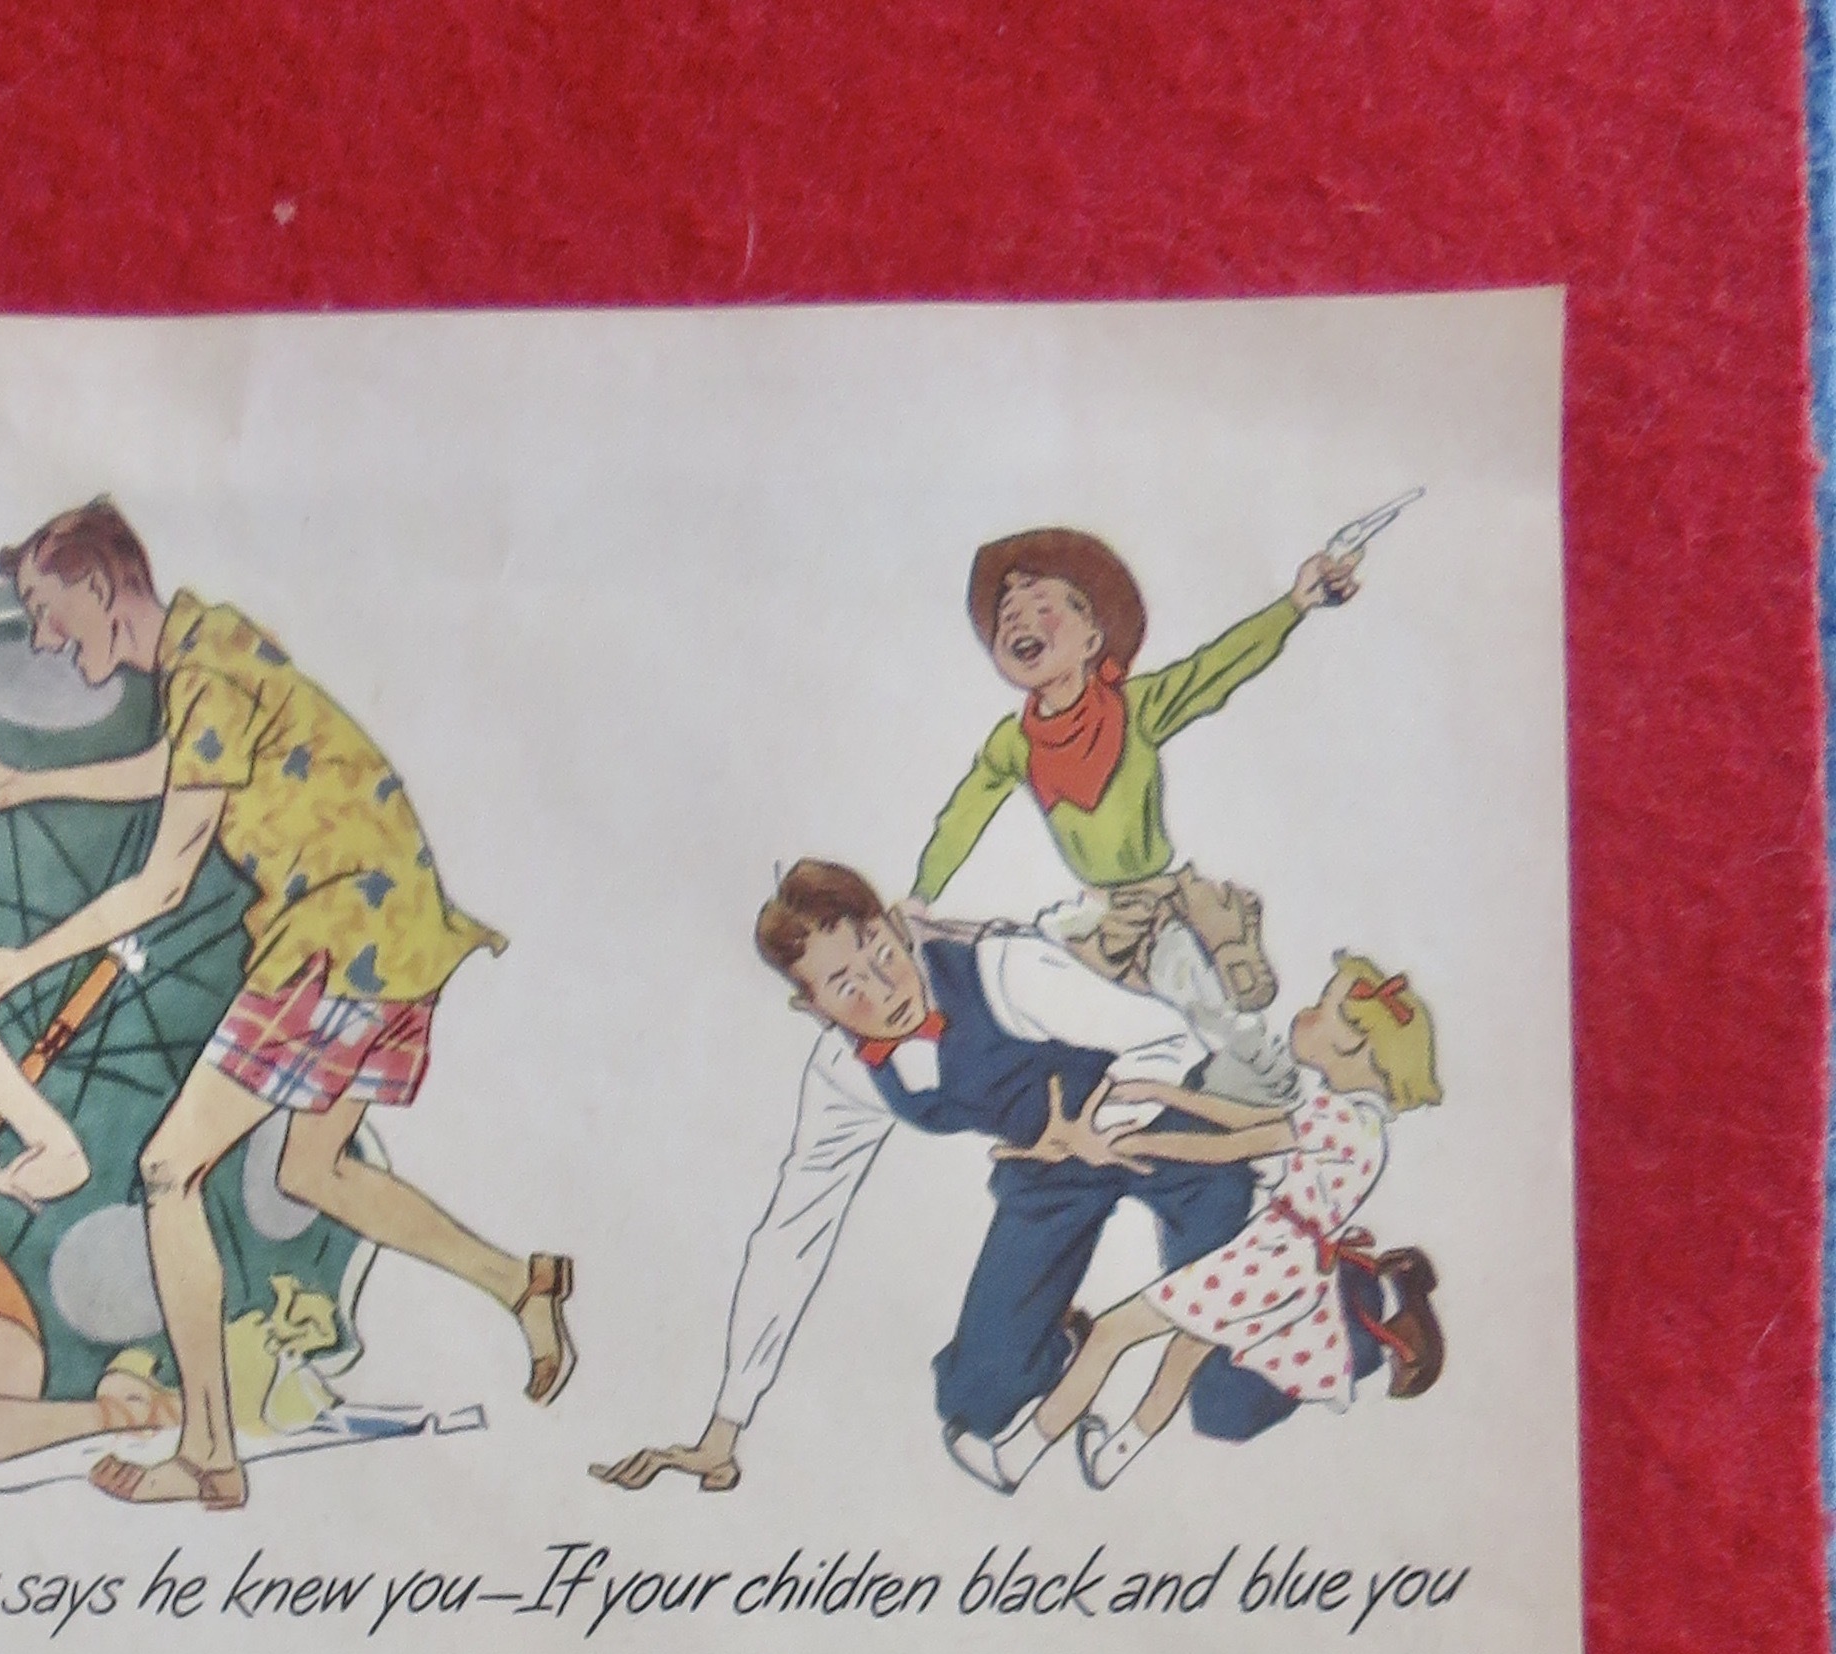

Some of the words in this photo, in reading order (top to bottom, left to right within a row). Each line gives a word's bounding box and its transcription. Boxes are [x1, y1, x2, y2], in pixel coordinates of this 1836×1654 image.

[0, 1573, 125, 1640] says
[138, 1546, 207, 1619] he
[221, 1547, 376, 1619] knew
[584, 1569, 732, 1640] your
[733, 1547, 943, 1619] children
[958, 1543, 1106, 1618] black
[1107, 1543, 1241, 1615] and
[1237, 1543, 1354, 1614] blue
[1348, 1563, 1472, 1636] you
